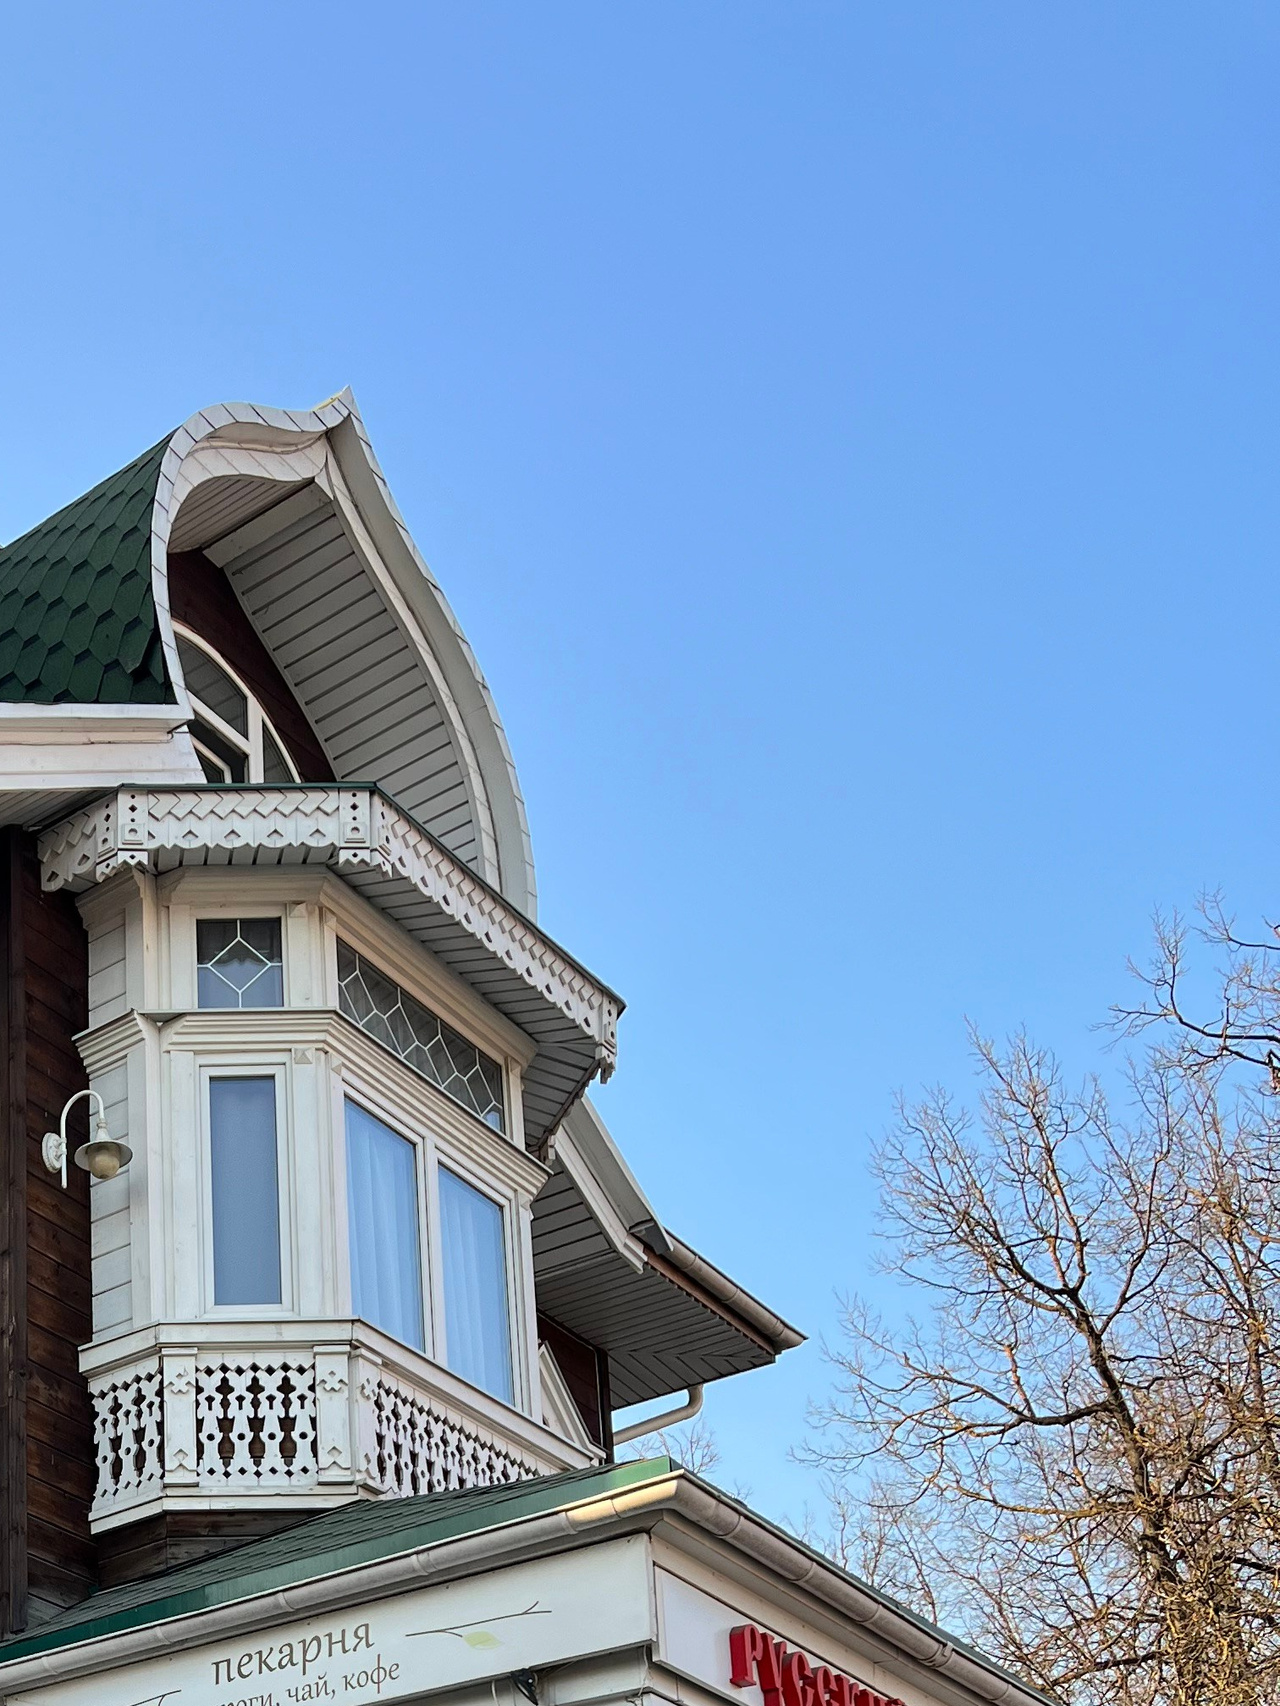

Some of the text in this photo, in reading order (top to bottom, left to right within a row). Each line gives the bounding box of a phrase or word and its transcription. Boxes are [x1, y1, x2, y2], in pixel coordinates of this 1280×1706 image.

[211, 1622, 375, 1686] пекарня
[285, 1673, 336, 1704] чай,
[342, 1654, 401, 1694] кофе
